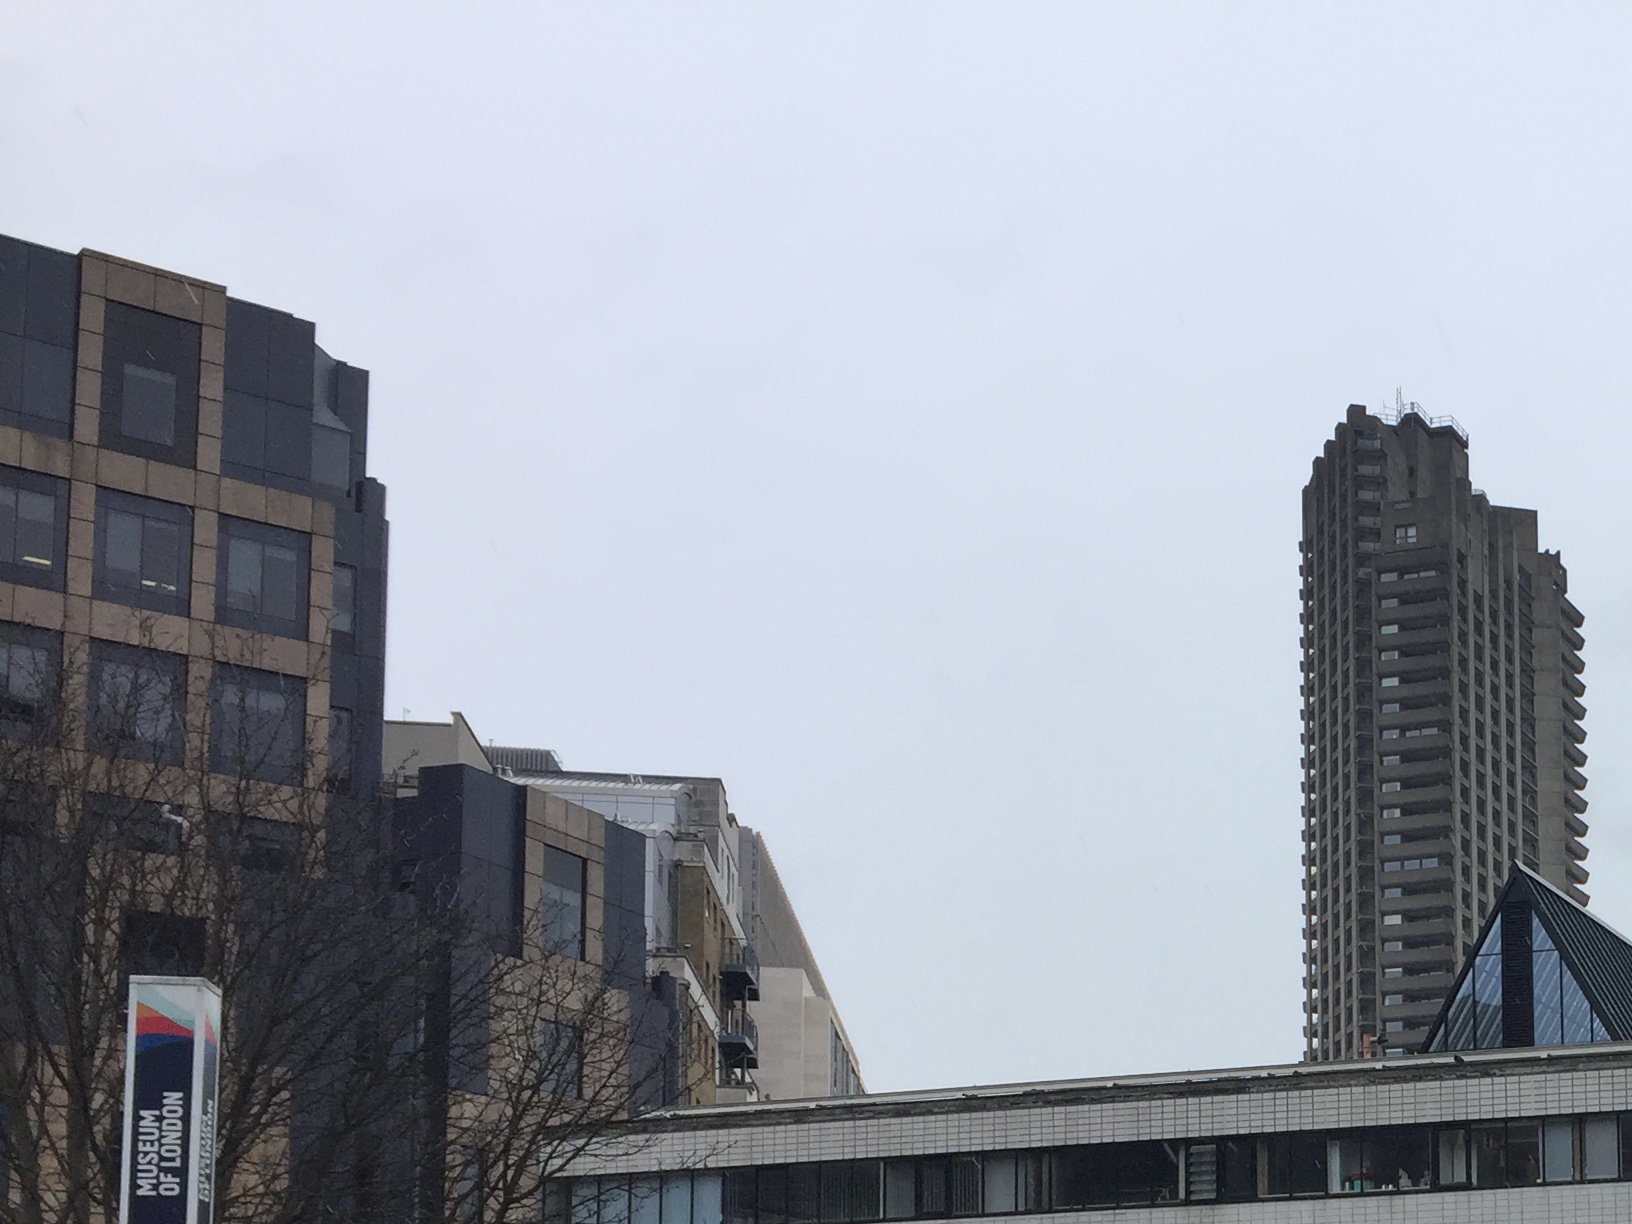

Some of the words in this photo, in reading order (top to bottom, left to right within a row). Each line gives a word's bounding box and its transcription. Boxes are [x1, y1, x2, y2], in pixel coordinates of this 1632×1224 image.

[136, 1109, 160, 1196] MUSEUM
[161, 1092, 184, 1168] LONDON
[160, 1171, 181, 1197] OF
